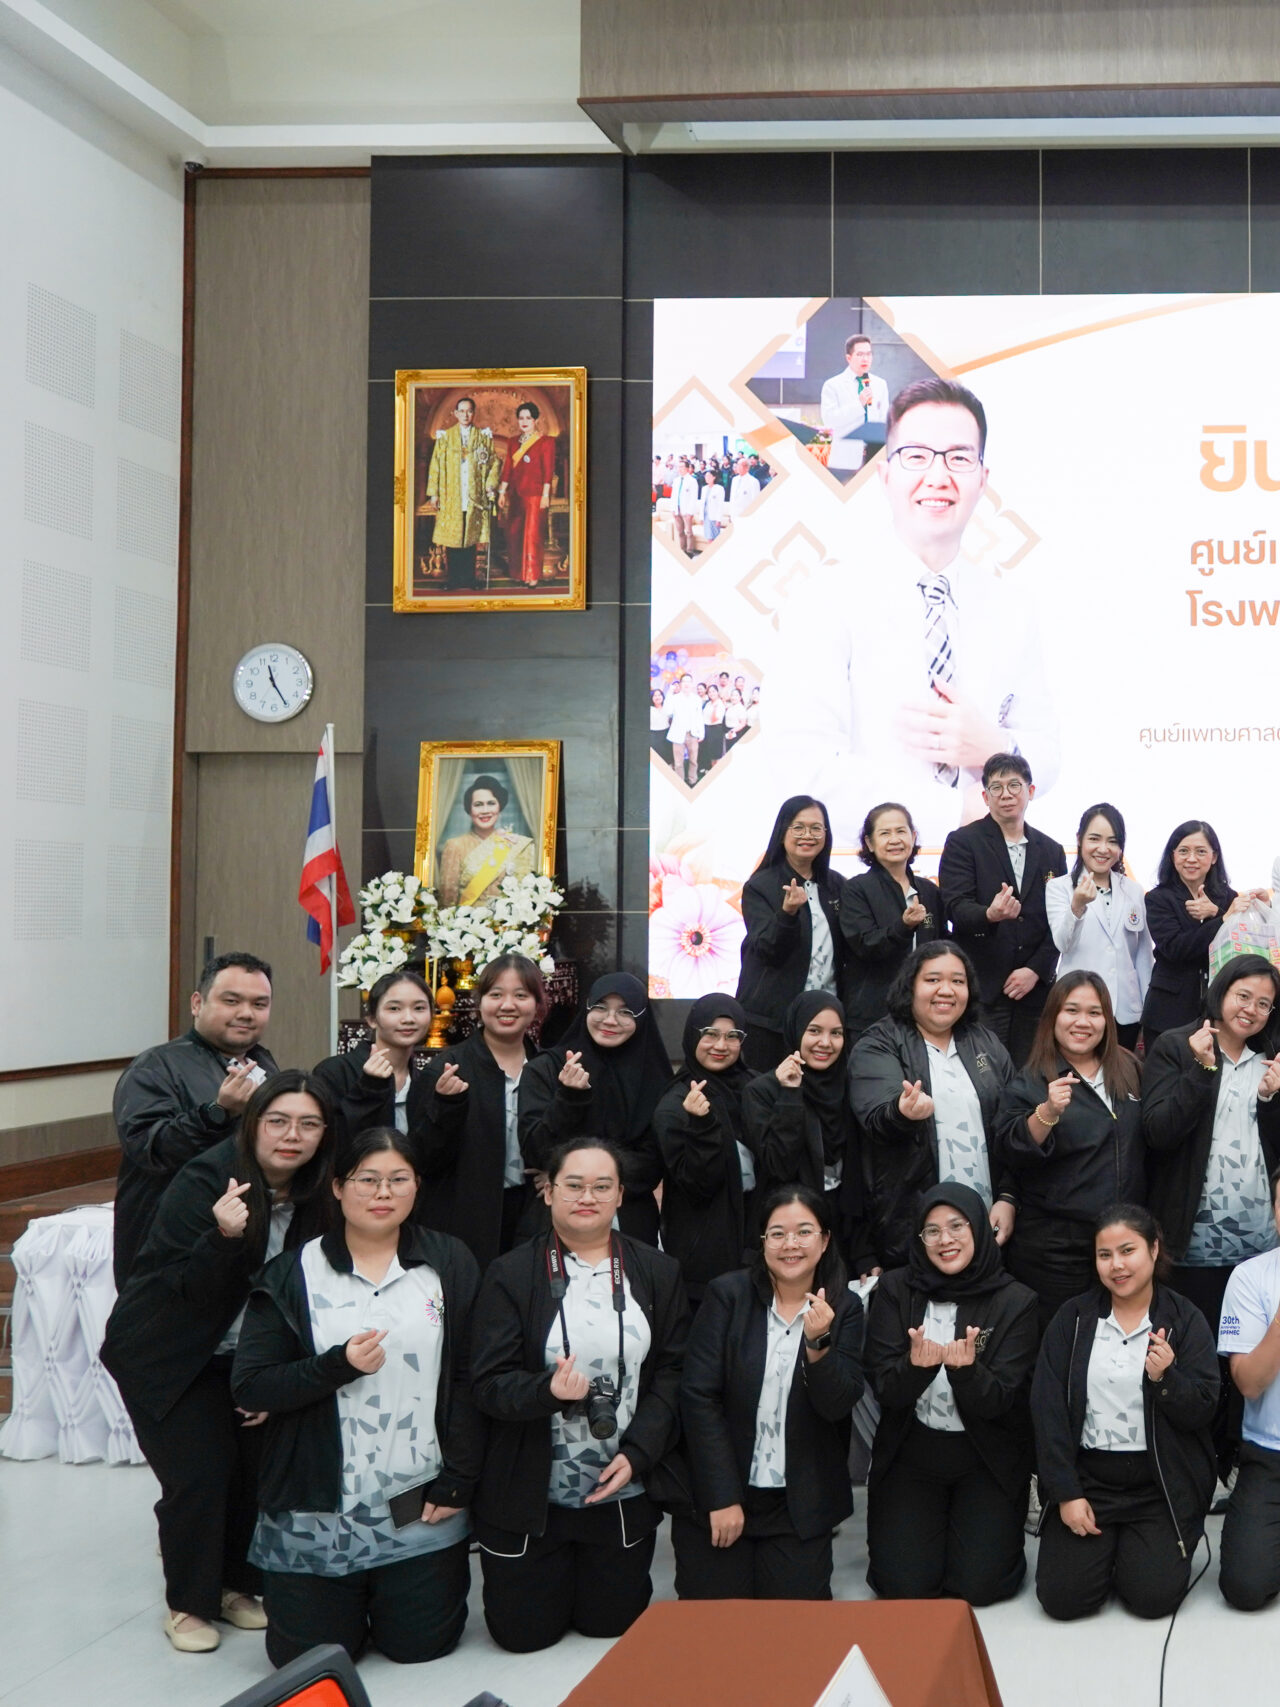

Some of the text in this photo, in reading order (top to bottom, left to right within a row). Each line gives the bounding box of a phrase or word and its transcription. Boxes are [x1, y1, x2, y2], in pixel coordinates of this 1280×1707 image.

[270, 654, 279, 662] 12
[250, 667, 260, 675] 10
[550, 1249, 559, 1273] Canon
[1222, 1315, 1240, 1325] 30th
